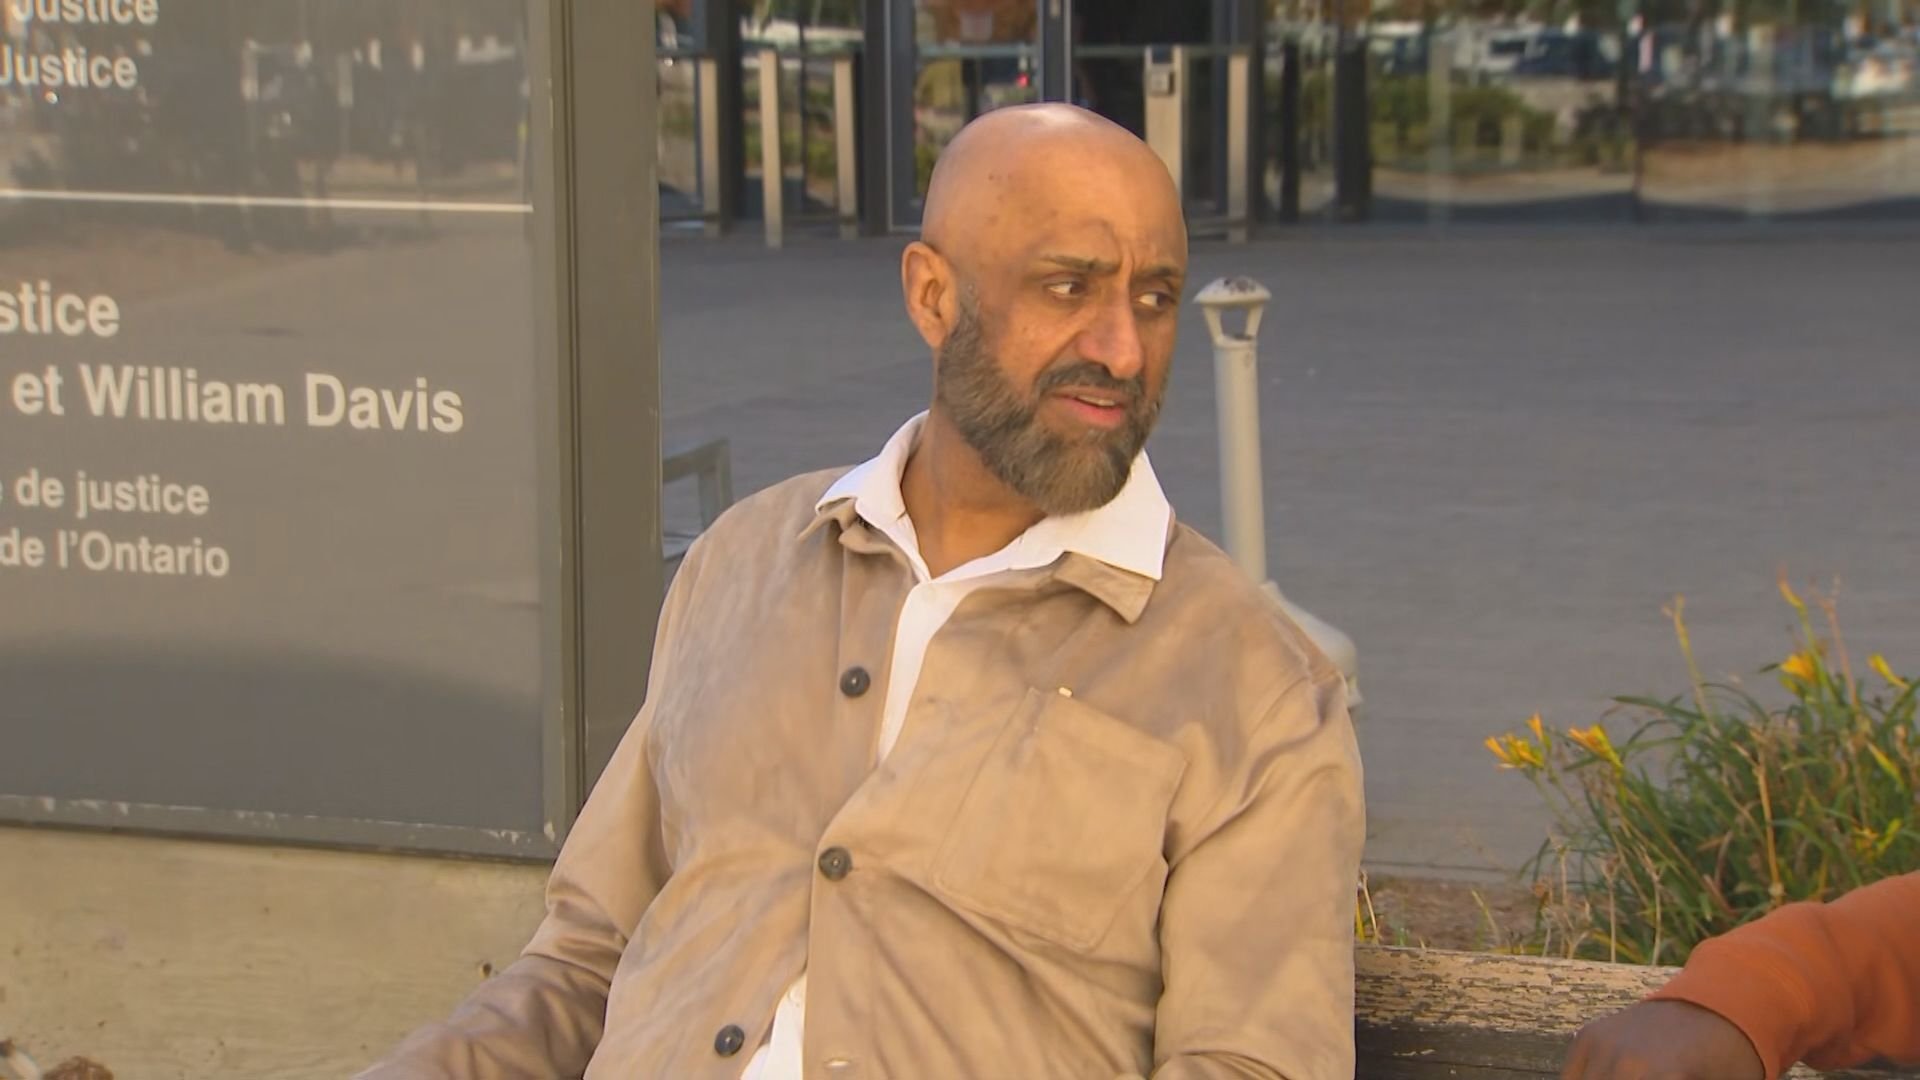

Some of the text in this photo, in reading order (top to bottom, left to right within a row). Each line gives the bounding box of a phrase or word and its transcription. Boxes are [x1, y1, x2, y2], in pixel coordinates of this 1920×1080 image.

[0, 47, 137, 88] Justice
[0, 280, 120, 337] stice
[12, 364, 464, 433] et William Davis
[16, 468, 65, 508] de
[77, 471, 210, 519] justice
[0, 528, 230, 577] de l’Ontario
